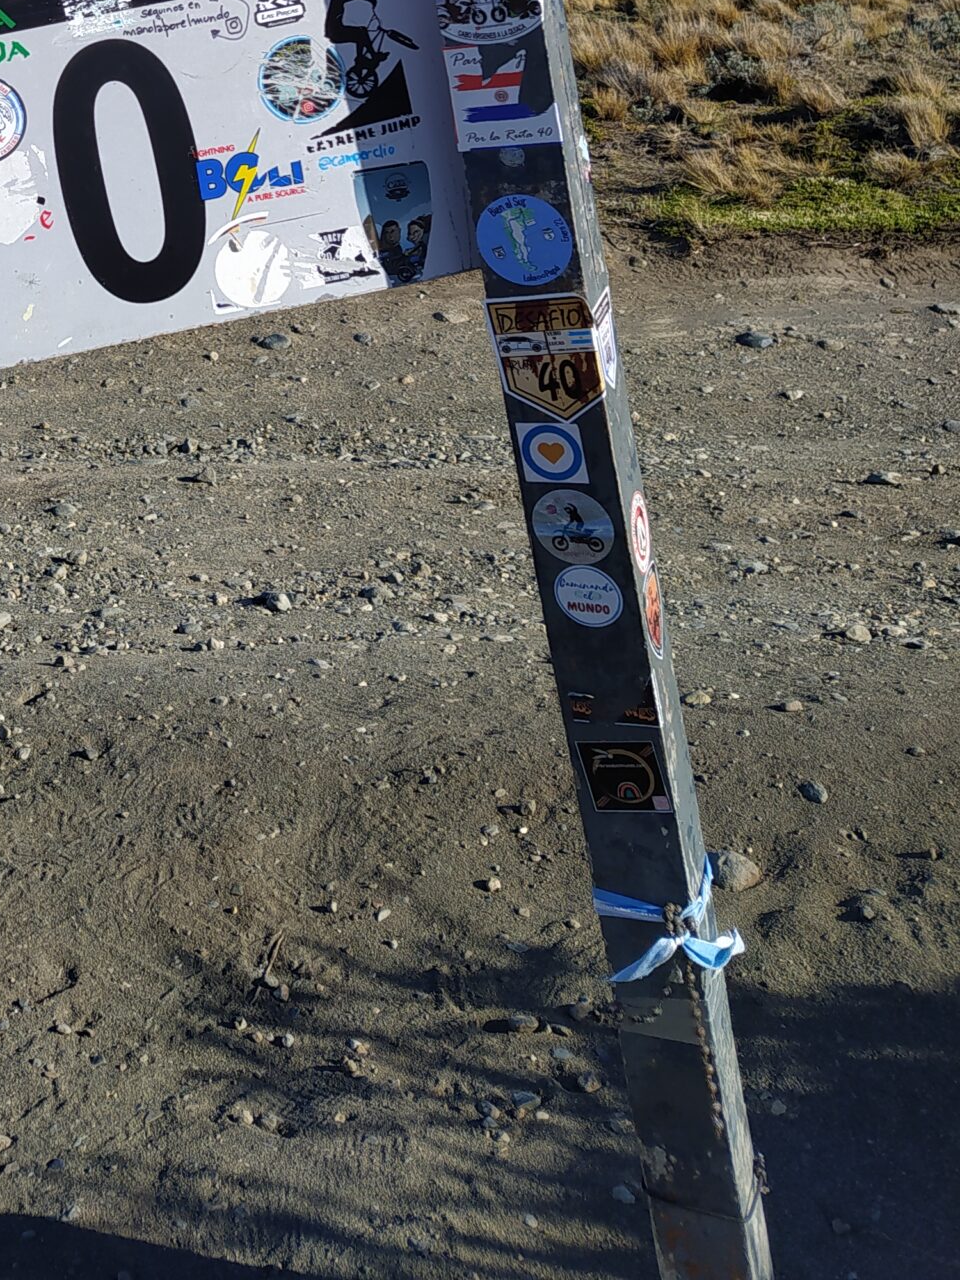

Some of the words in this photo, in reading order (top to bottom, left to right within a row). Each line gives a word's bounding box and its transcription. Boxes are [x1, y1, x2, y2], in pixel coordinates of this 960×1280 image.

[140, 3, 185, 20] seguinos
[188, 2, 201, 10] en
[381, 115, 421, 136] JUMP
[466, 131, 487, 143] Por
[490, 128, 501, 141] la
[506, 129, 533, 141] Ruta
[536, 126, 553, 138] 40
[53, 38, 206, 304] 0
[247, 195, 254, 203] A
[254, 192, 274, 202] PURE
[538, 359, 582, 401] 40
[582, 591, 593, 601] el
[567, 601, 611, 615] MUNDO
